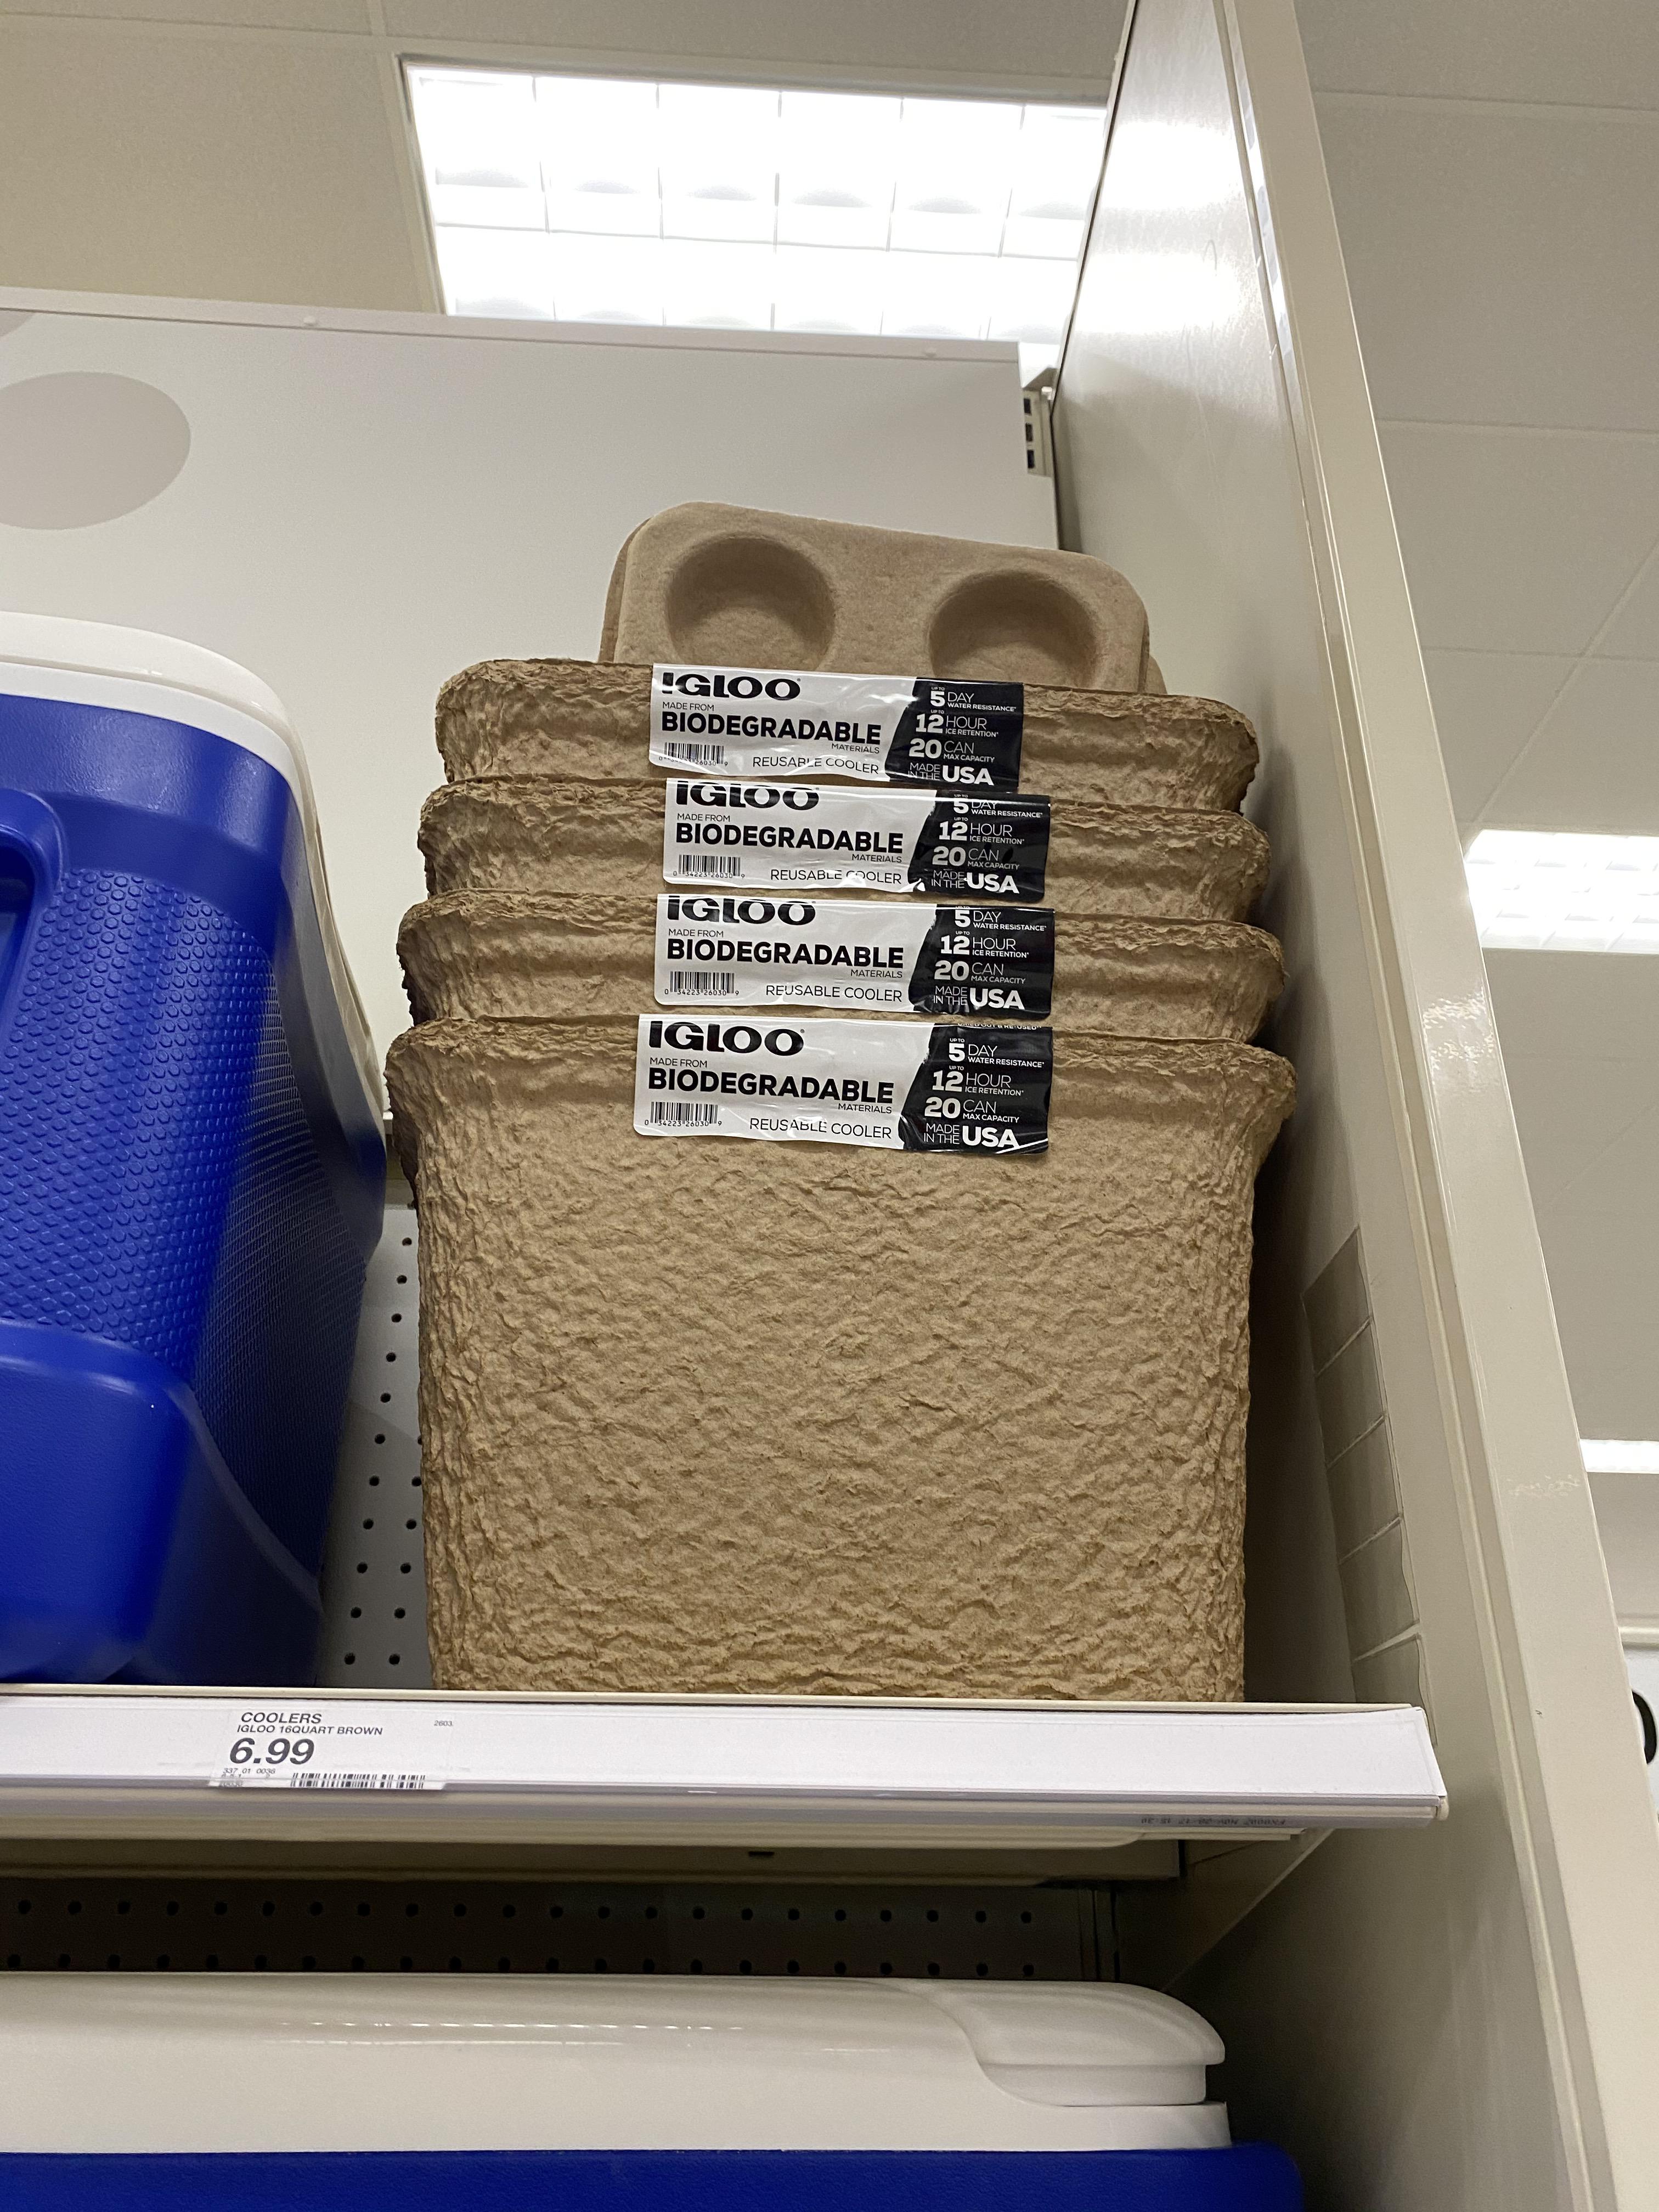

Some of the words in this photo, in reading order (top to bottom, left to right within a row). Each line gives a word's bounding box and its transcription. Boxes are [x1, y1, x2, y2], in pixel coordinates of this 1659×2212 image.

[662, 672, 800, 701] IGLOO
[662, 702, 687, 710] MADE
[930, 691, 945, 707] 5
[947, 691, 974, 703] DAY
[662, 711, 881, 745] BIODEGRADABLE
[916, 713, 944, 734] 12
[946, 715, 987, 730] HOUR
[832, 743, 879, 754] MATERIALS
[909, 738, 942, 759] 20
[944, 741, 974, 754] CAN
[753, 757, 822, 767] REUSABLE
[826, 758, 879, 774] COOLER
[961, 754, 995, 763] CAPACITY
[908, 770, 917, 778] IN
[918, 771, 941, 781] THE
[910, 762, 941, 773] MADE
[942, 765, 995, 786] USA
[676, 781, 819, 811] IGLOO
[953, 799, 969, 814] 5
[971, 800, 999, 810] DAY
[677, 813, 703, 821] MADE
[676, 822, 903, 854] BIODEGRADABLE
[939, 821, 968, 841] 12
[970, 823, 1013, 837] HOUR
[852, 854, 902, 863] MATERIALS
[932, 846, 966, 866] 20
[968, 848, 999, 862] CAN
[984, 862, 1020, 870] CAPACITY
[771, 869, 842, 881] REUSABLE
[933, 870, 964, 880] MADE
[966, 872, 1020, 894] USA
[931, 879, 941, 887] IN
[944, 879, 965, 889] THE
[667, 895, 816, 926] IGLOO
[955, 909, 971, 928] 5
[973, 910, 1001, 923] DAY
[668, 928, 695, 936] MADE
[697, 929, 724, 938] FROM
[667, 938, 904, 968] BIODEGRADABLE
[940, 935, 970, 956] 12
[973, 936, 1016, 951] HOUR
[850, 969, 902, 978] MATERIALS
[934, 960, 970, 981] 20
[972, 962, 1004, 975] CAN
[989, 976, 1026, 984] CAPACITY
[766, 985, 840, 997] REUSABLE
[844, 987, 902, 1002] COOLER
[935, 985, 968, 997] MADE
[969, 988, 1025, 1010] USA
[933, 995, 943, 1005] IN
[946, 996, 968, 1006] THE
[649, 1020, 804, 1056] IGLOO
[949, 1042, 965, 1062] 5
[968, 1044, 998, 1057] DAY
[968, 1056, 995, 1064] WATER
[650, 1057, 678, 1066] MADE
[680, 1059, 707, 1068] FROM
[648, 1067, 894, 1104] BIODEGRADABLE
[932, 1070, 963, 1092] 12
[966, 1072, 1011, 1088] HOUR
[838, 1103, 892, 1114] MATERIALS
[924, 1097, 961, 1119] 20
[963, 1099, 997, 1114] CAN
[981, 1114, 1019, 1123] CAPACITY
[750, 1118, 827, 1132] REUSABLE
[831, 1122, 891, 1139] COOLER
[926, 1122, 960, 1134] MADE
[923, 1133, 934, 1143] IN
[937, 1133, 960, 1144] THE
[962, 1125, 1020, 1148] USA
[241, 1712, 322, 1724] COOLERS
[237, 1724, 275, 1733] IGLOO
[280, 1725, 335, 1734] 16QUART
[337, 1726, 383, 1735] BROWN
[229, 1737, 314, 1765] 6.99
